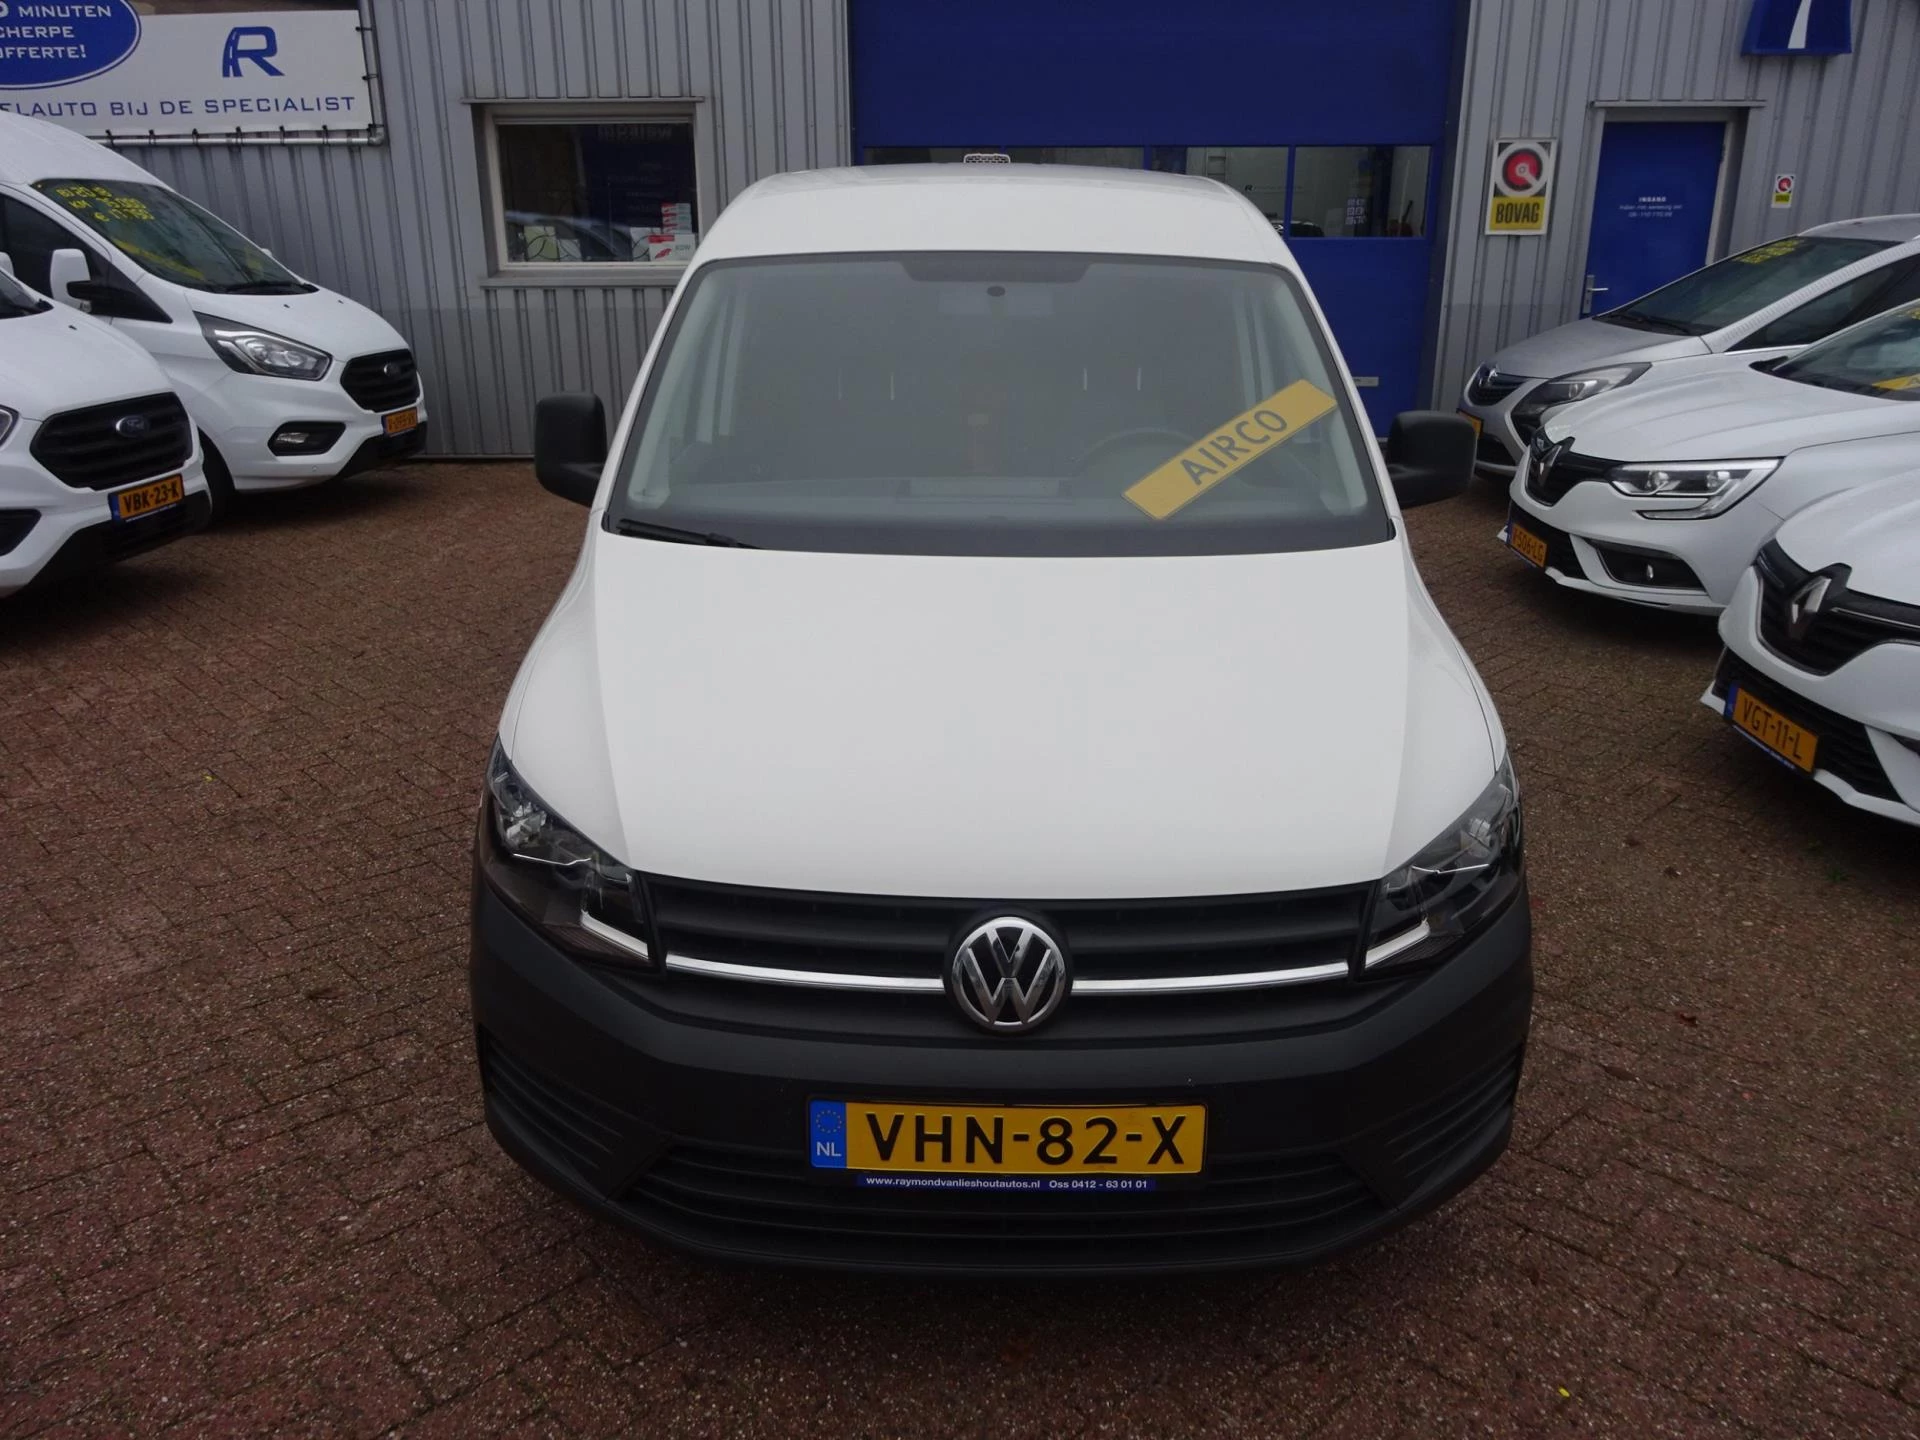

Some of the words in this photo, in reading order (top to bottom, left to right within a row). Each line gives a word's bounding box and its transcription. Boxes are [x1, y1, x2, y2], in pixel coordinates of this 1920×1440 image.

[18, 5, 112, 18] MINUTEN
[0, 44, 87, 59] FFERTE!
[110, 102, 149, 116] BIJ
[160, 100, 193, 115] DE
[205, 96, 355, 114] SPECIALIST
[1495, 202, 1541, 224] BOVAG
[1180, 410, 1288, 486] AIRCO
[1743, 697, 1802, 762] VGT-11-L
[865, 1112, 1187, 1166] VHN-82-X
[816, 1142, 842, 1157] NL
[866, 1176, 1041, 1188] www.raymondvanlieshoutautos.nl
[1049, 1180, 1069, 1189] Oss
[1071, 1180, 1097, 1189] 0412
[1105, 1180, 1119, 1189] 63
[1121, 1180, 1132, 1189] 01
[1136, 1180, 1147, 1189] 01
